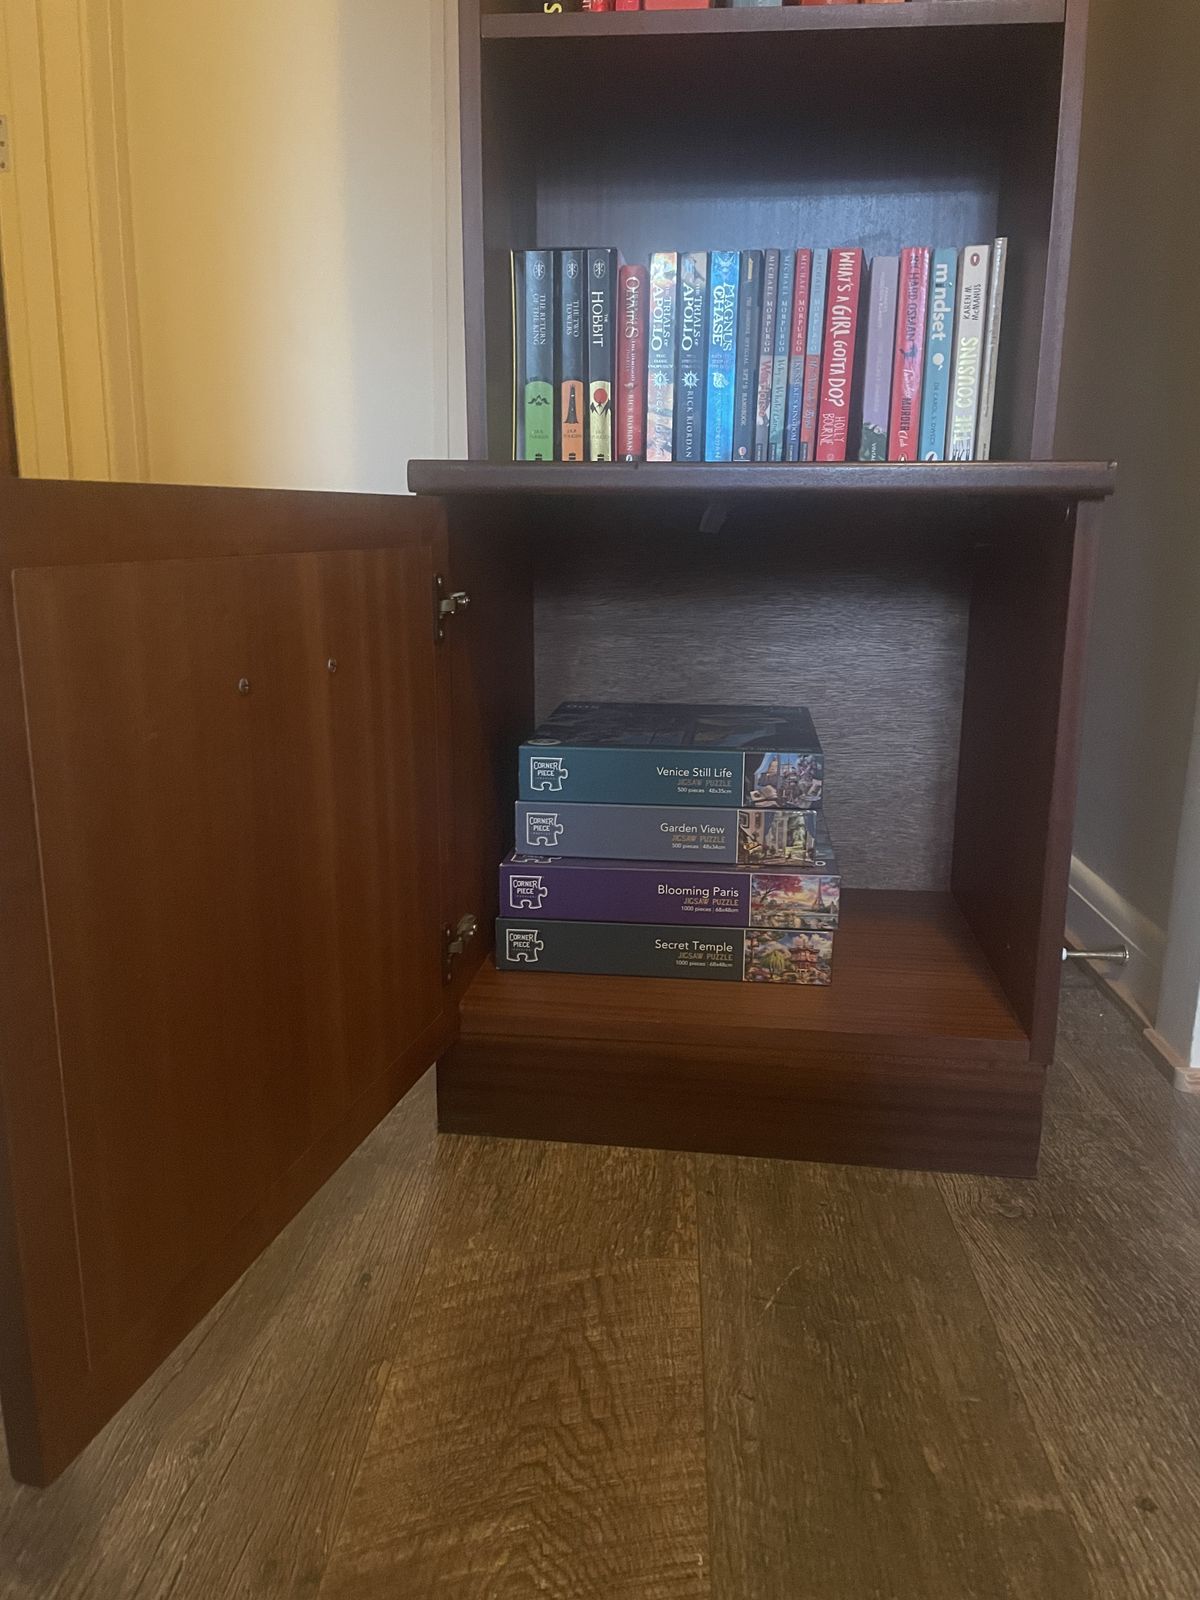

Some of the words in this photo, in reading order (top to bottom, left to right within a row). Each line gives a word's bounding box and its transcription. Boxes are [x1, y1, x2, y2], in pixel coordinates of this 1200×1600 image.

[767, 255, 775, 296] MICHAEL
[782, 255, 790, 296] MICHAEL
[799, 254, 808, 295] MICHAEL
[836, 251, 856, 292] WHAT'S
[907, 255, 921, 301] RICHARD
[572, 300, 580, 316] THE
[624, 276, 640, 338] OLYMPUS
[836, 295, 847, 303] A
[931, 263, 953, 341] mindset
[962, 295, 972, 320] KAREN
[971, 283, 981, 321] McMANUS
[572, 319, 580, 337] TWO
[591, 291, 604, 347] HOBBIT
[651, 282, 664, 351] APOLLO
[663, 296, 672, 338] TRIALS
[681, 282, 694, 351] APOLLO
[693, 295, 703, 338] TRIALS
[712, 285, 725, 347] CHASE
[723, 282, 736, 351] MAGNUS
[830, 305, 852, 338] GIRL
[905, 303, 918, 342] OSMAN
[829, 340, 848, 375] GOTTA
[955, 336, 979, 409] COUSINS
[627, 394, 635, 411] RICK
[686, 390, 694, 413] RICK
[825, 378, 847, 407] DO?
[790, 405, 800, 441] KINGDOM
[819, 413, 835, 446] BOURNE
[834, 415, 846, 443] HOLLY
[899, 398, 912, 432] MURDER
[953, 414, 973, 445] THE
[626, 415, 634, 451] RIORDAN
[685, 416, 693, 458] RIORDAN
[533, 761, 559, 770] CORNER
[656, 766, 690, 777] Venice
[692, 767, 711, 777] Still
[714, 767, 733, 778] Life
[529, 816, 554, 825] CORNER
[660, 822, 698, 833] Garden
[700, 824, 725, 834] View
[699, 835, 726, 843] PUZZLE
[512, 879, 538, 889] CORNER
[657, 884, 710, 898] Blooming
[712, 886, 739, 897] Paris
[683, 897, 710, 905] JIGSAW
[712, 898, 739, 906] PUZZLE
[509, 933, 534, 942] CORNER
[655, 938, 689, 950] Secret
[692, 940, 733, 954] Temple
[678, 951, 704, 959] JIGSAW
[706, 953, 734, 961] PUZZLE
